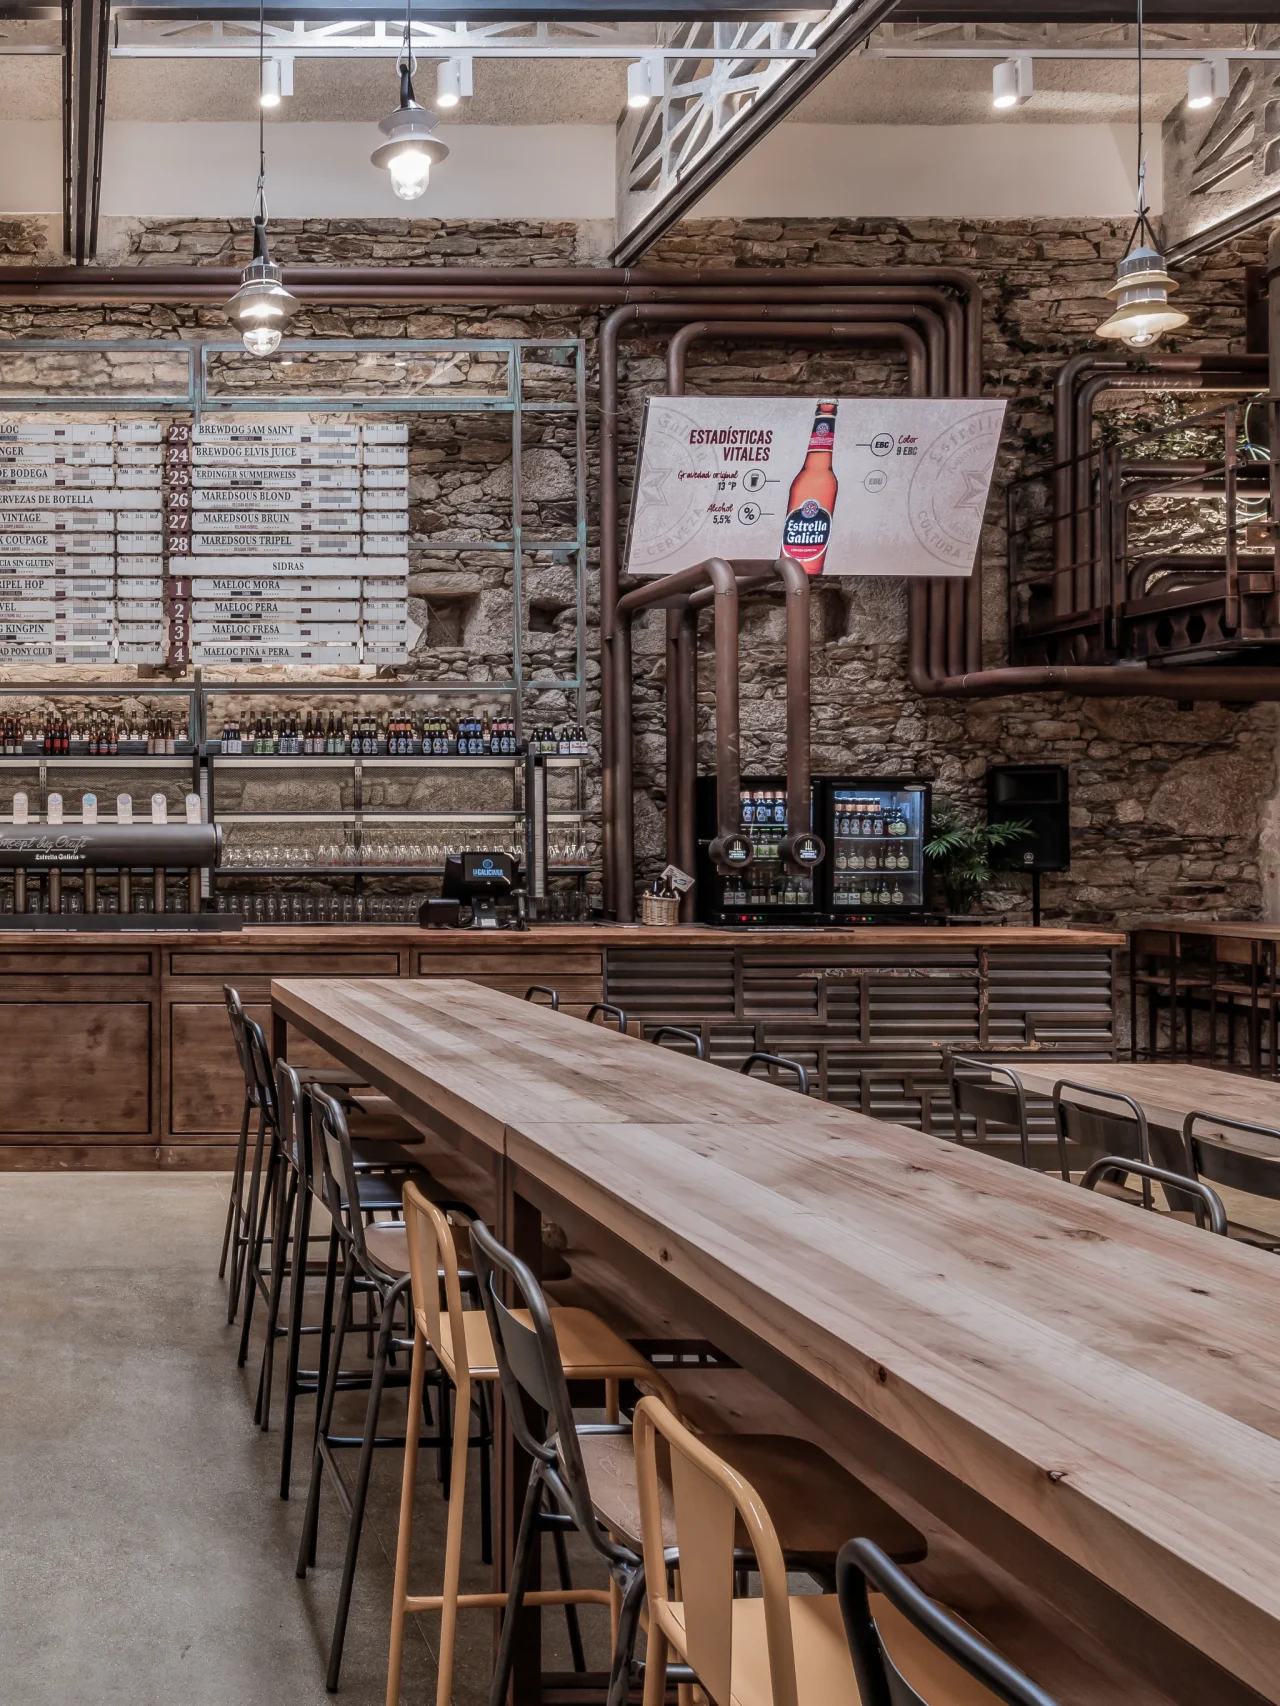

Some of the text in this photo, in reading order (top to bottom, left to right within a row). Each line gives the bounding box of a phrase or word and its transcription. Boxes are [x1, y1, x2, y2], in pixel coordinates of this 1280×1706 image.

[170, 427, 188, 440] 23
[199, 426, 293, 434] BREWDOG 5AM SAINT
[689, 426, 773, 445] ESTADÍSTICAS
[898, 435, 919, 444] Color
[170, 449, 188, 462] 24
[271, 448, 296, 458] JUICE
[723, 447, 770, 462] VITALES
[896, 447, 918, 456] 9 EBC
[11, 469, 48, 477] BODEGA
[170, 471, 188, 484] 25
[678, 470, 738, 481] Gravedad original
[718, 481, 725, 490] 13
[170, 493, 188, 506] 26
[202, 492, 290, 500] MAREDSOUS BLOND
[707, 502, 734, 513] Alcohol
[170, 515, 188, 528] 27
[713, 515, 731, 525] 5,5%
[787, 520, 827, 532] Estrella
[6, 536, 48, 544] COUPAGE
[202, 536, 291, 544] MAREDSOUS TRIPEL
[787, 532, 824, 544] Galicia
[170, 538, 188, 551] 28
[273, 562, 304, 570] SIDRAS
[25, 580, 44, 588] HOP
[176, 582, 183, 595] 1
[213, 580, 280, 589] MAELOC MORA
[175, 604, 184, 618] 2
[215, 603, 278, 611] MAELOC PERA
[175, 626, 184, 639] 3
[213, 625, 279, 633] MAELOC FRESA
[174, 649, 184, 661] 4
[241, 646, 259, 655] PIÑA
